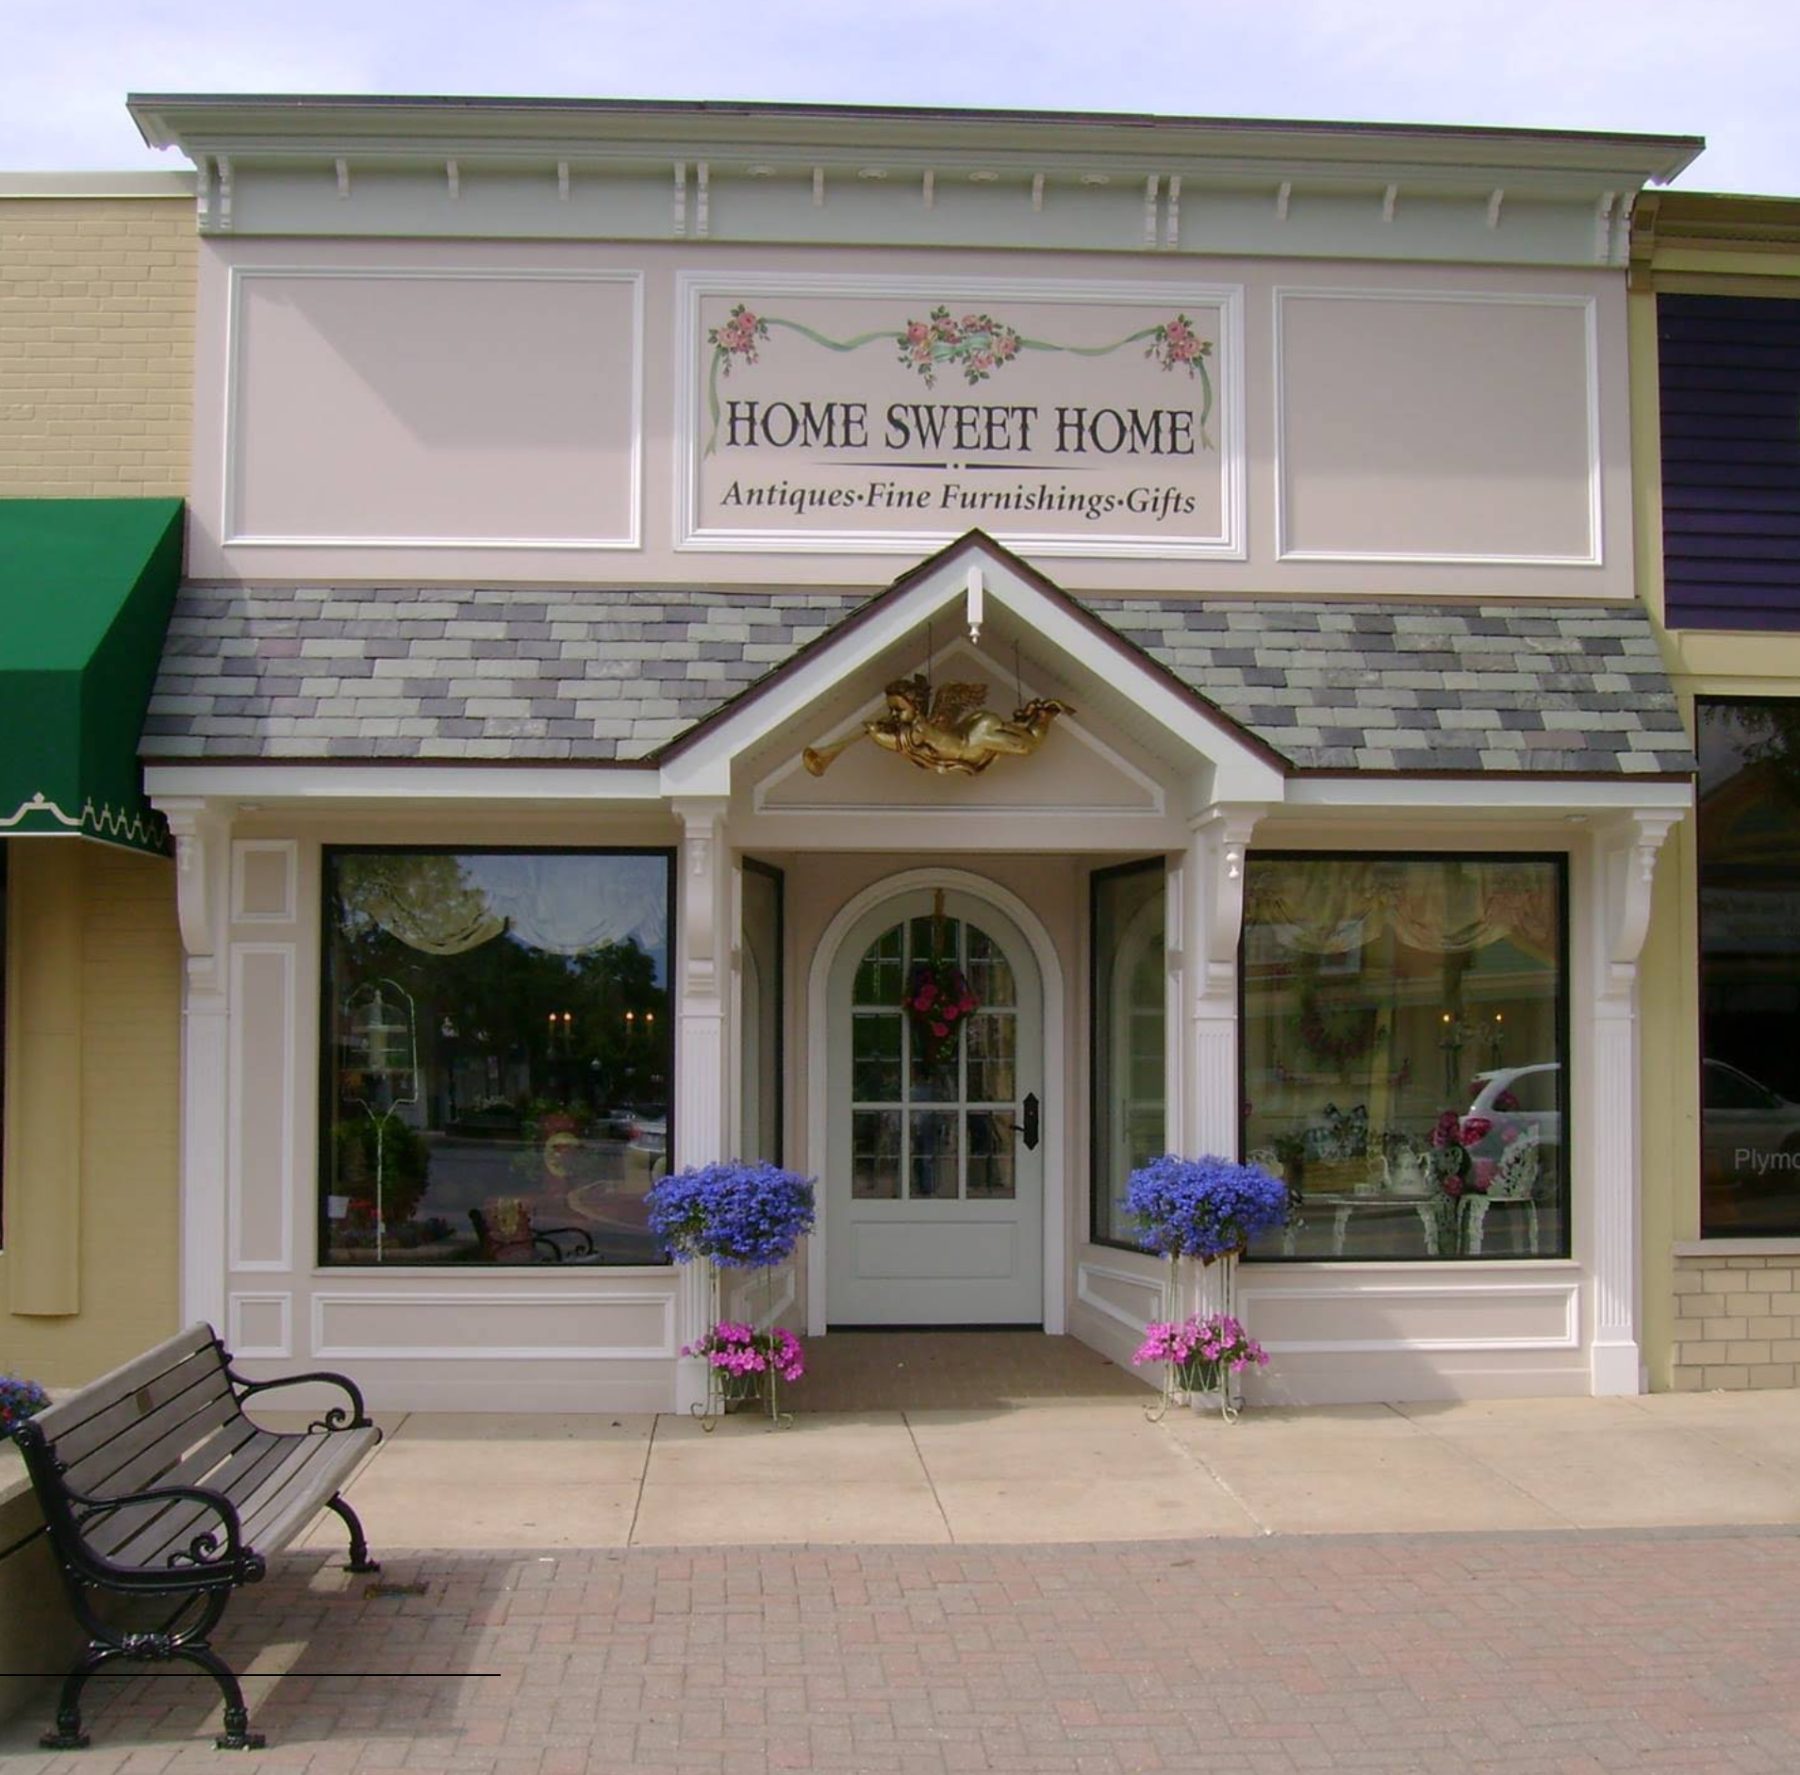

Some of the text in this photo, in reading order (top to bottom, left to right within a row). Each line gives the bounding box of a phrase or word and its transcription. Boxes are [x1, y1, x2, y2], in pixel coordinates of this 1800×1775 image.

[726, 401, 1195, 455] HOME SWEET HOME
